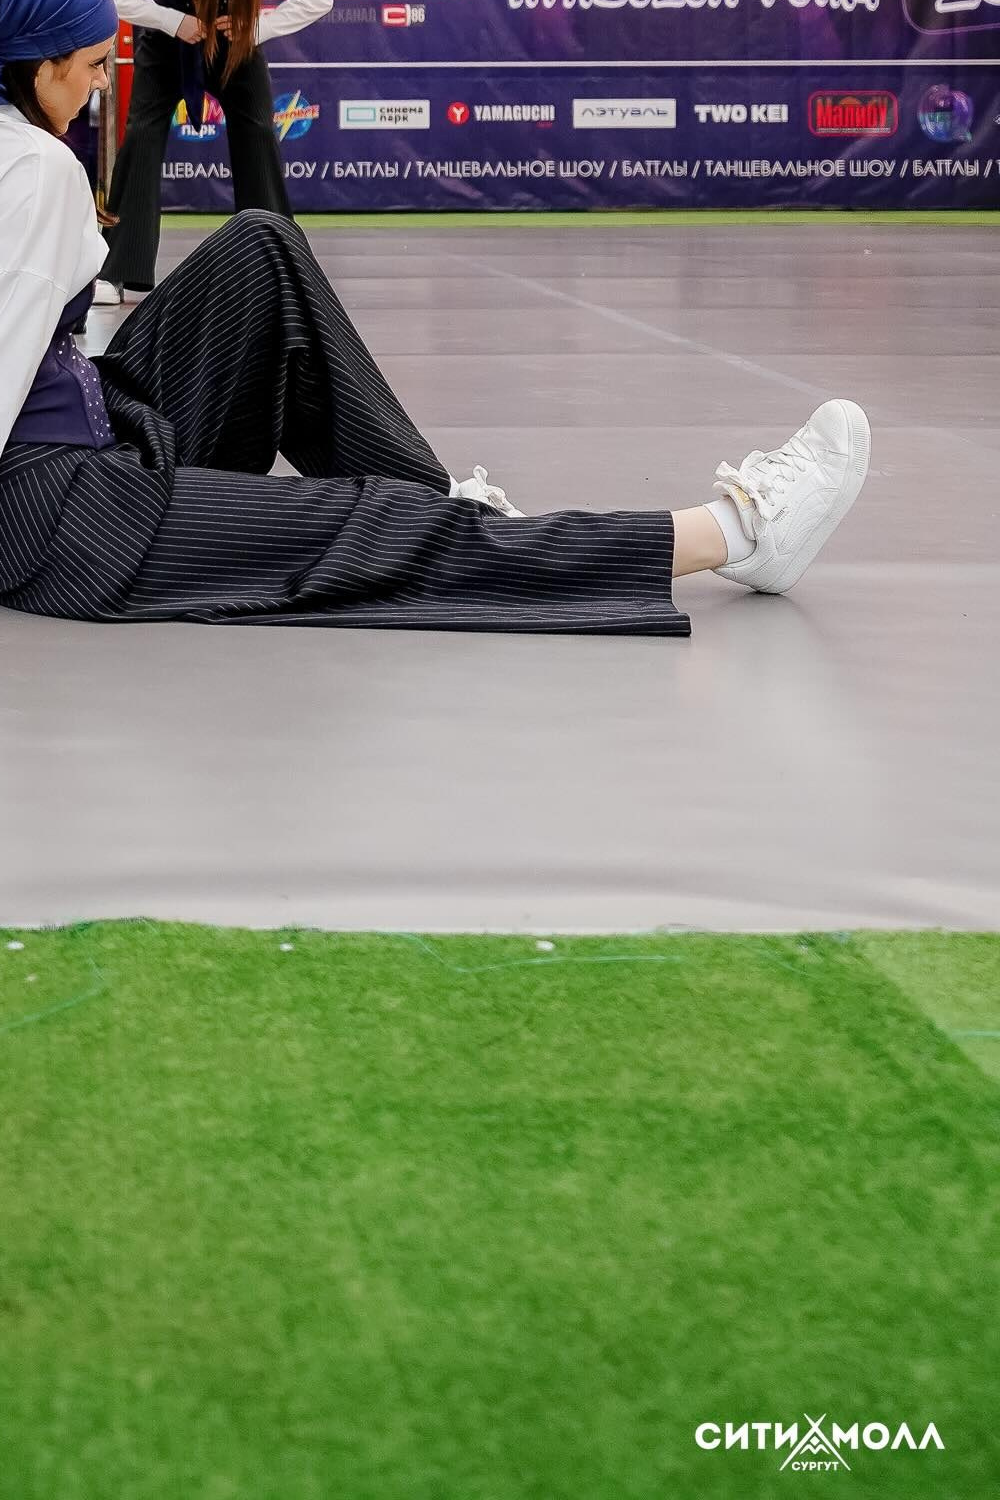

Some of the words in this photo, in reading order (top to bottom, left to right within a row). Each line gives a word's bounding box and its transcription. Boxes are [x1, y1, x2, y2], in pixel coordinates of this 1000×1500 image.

[474, 105, 556, 121] YAMAGUCHI
[694, 104, 748, 123] TWO
[751, 104, 789, 123] KEI
[334, 161, 399, 178] БАТТЛЫ
[415, 160, 555, 180] ТАНЦЕВАЛЬНОЕ
[559, 160, 605, 178] ШОУ
[622, 160, 688, 178] БАТТЛЫ
[705, 159, 846, 180] ТАНЦЕВАЛЬНОЕ
[850, 159, 896, 177] ШОУ
[913, 159, 980, 177] БАТТЛЫ
